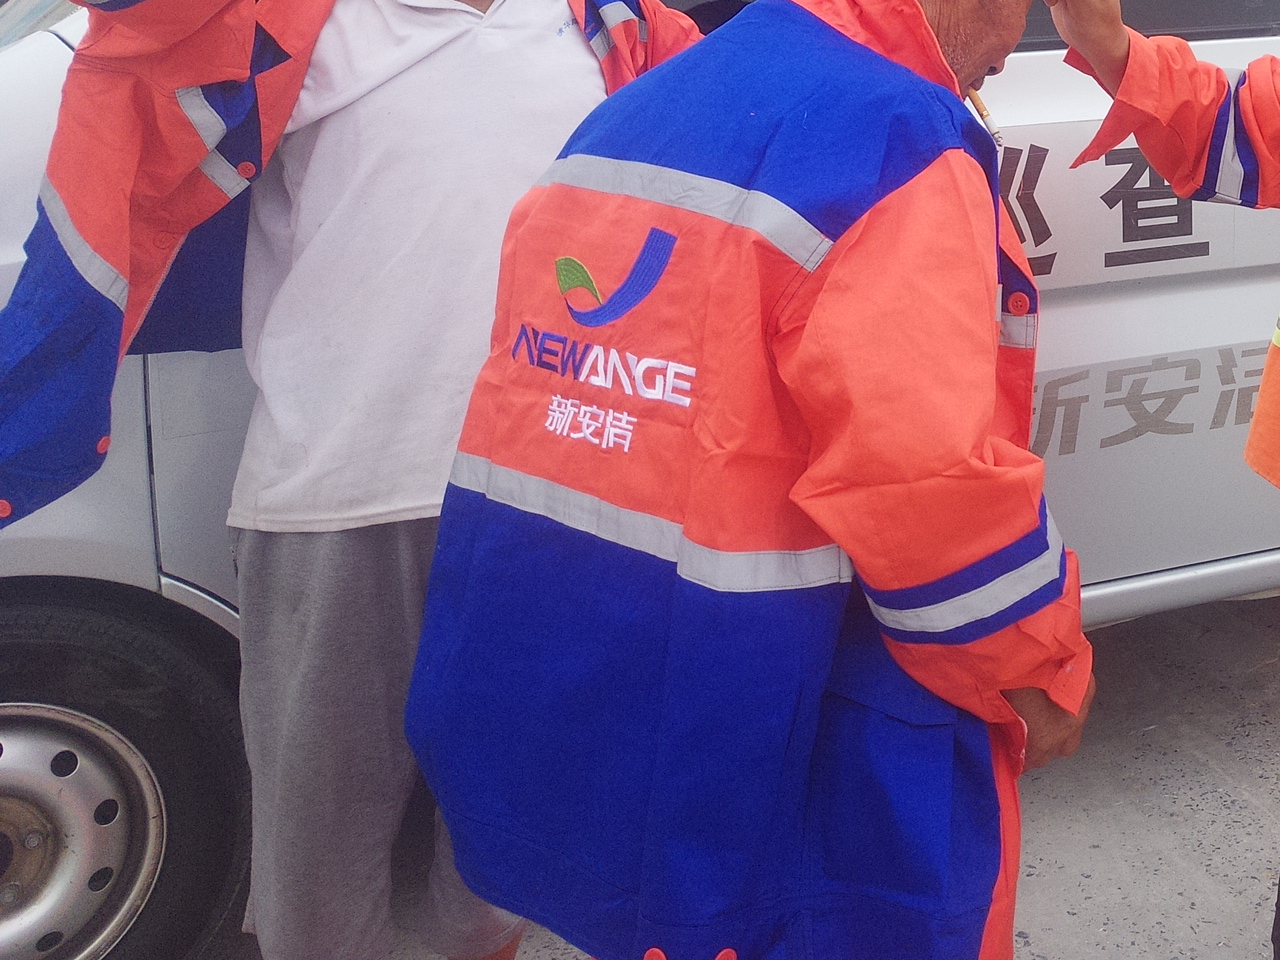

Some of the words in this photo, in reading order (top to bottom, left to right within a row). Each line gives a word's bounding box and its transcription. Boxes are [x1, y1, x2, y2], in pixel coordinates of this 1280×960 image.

[511, 323, 697, 408] NEWANGE
[544, 394, 638, 453] 新安洁
